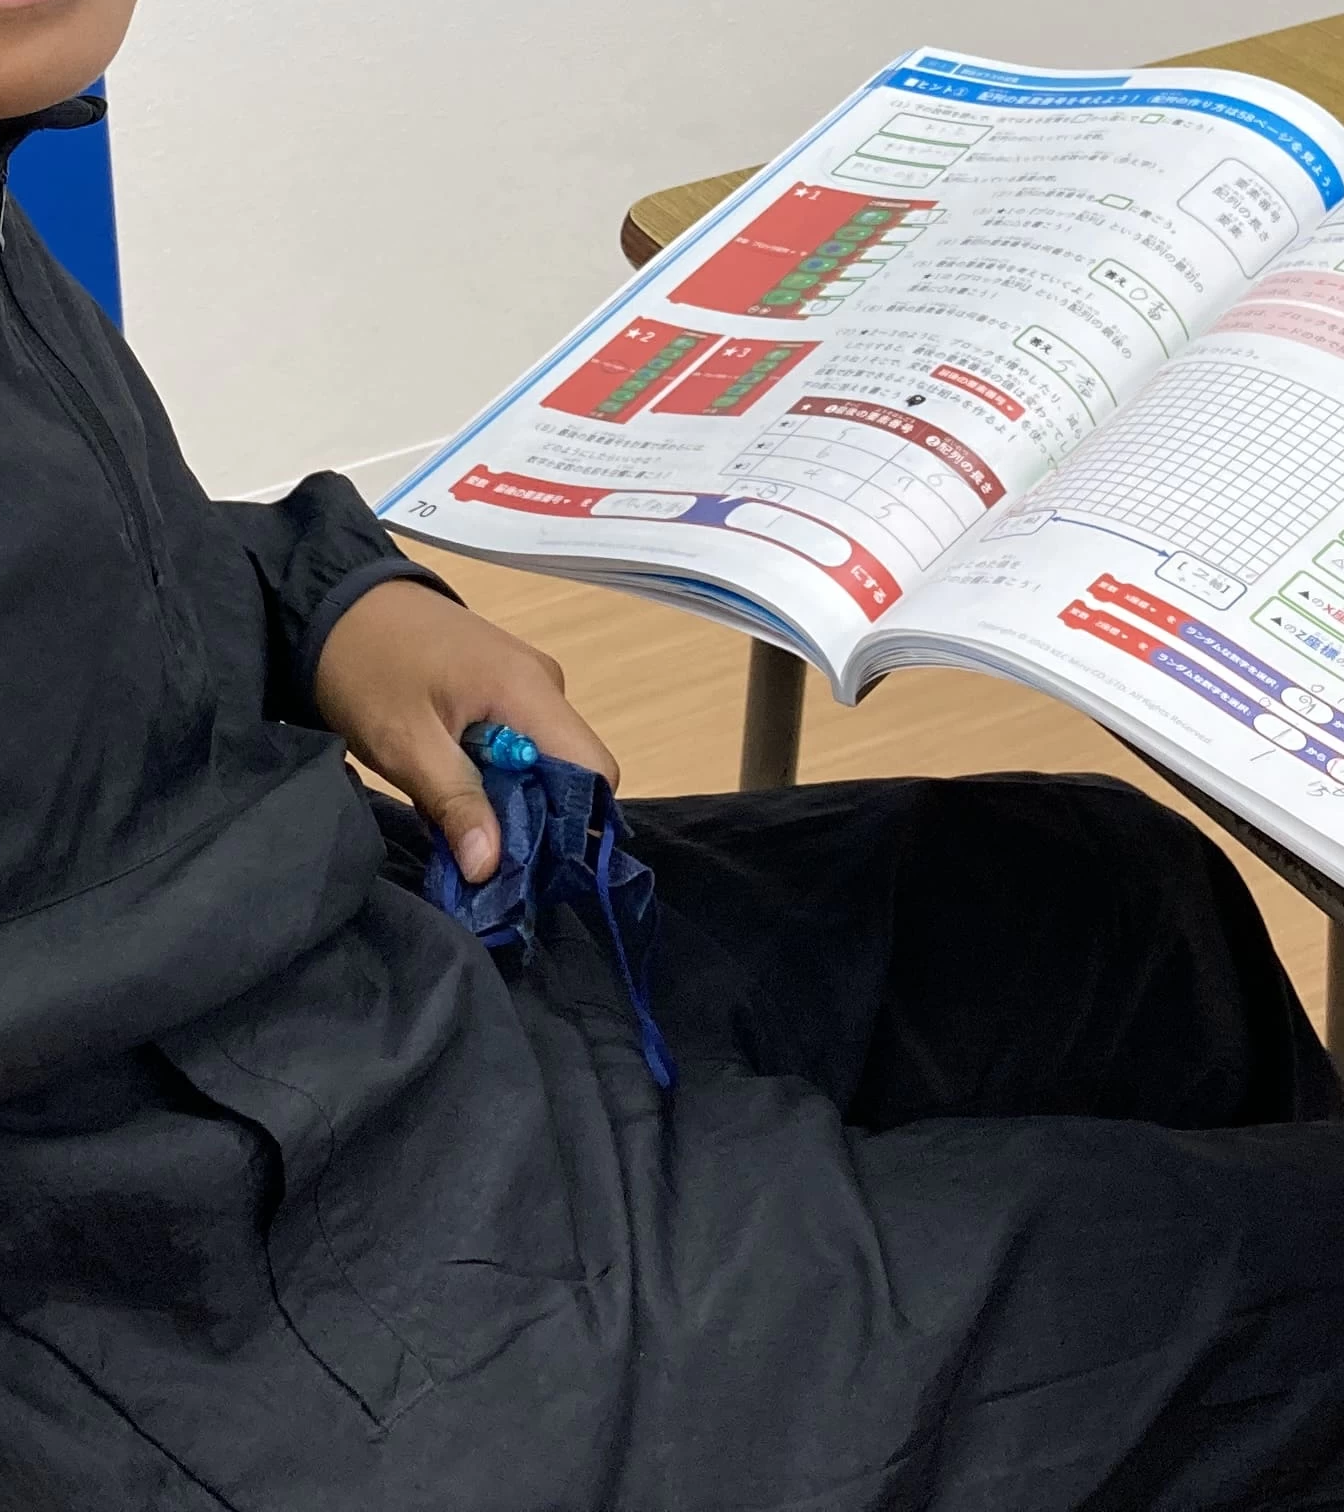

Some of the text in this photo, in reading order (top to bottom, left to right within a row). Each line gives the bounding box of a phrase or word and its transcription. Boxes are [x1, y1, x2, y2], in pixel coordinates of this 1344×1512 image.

[1104, 270, 1127, 288] 答え
[1029, 336, 1053, 355] 答え
[408, 500, 436, 518] 70
[850, 564, 888, 604] にする
[1304, 746, 1328, 763] から
